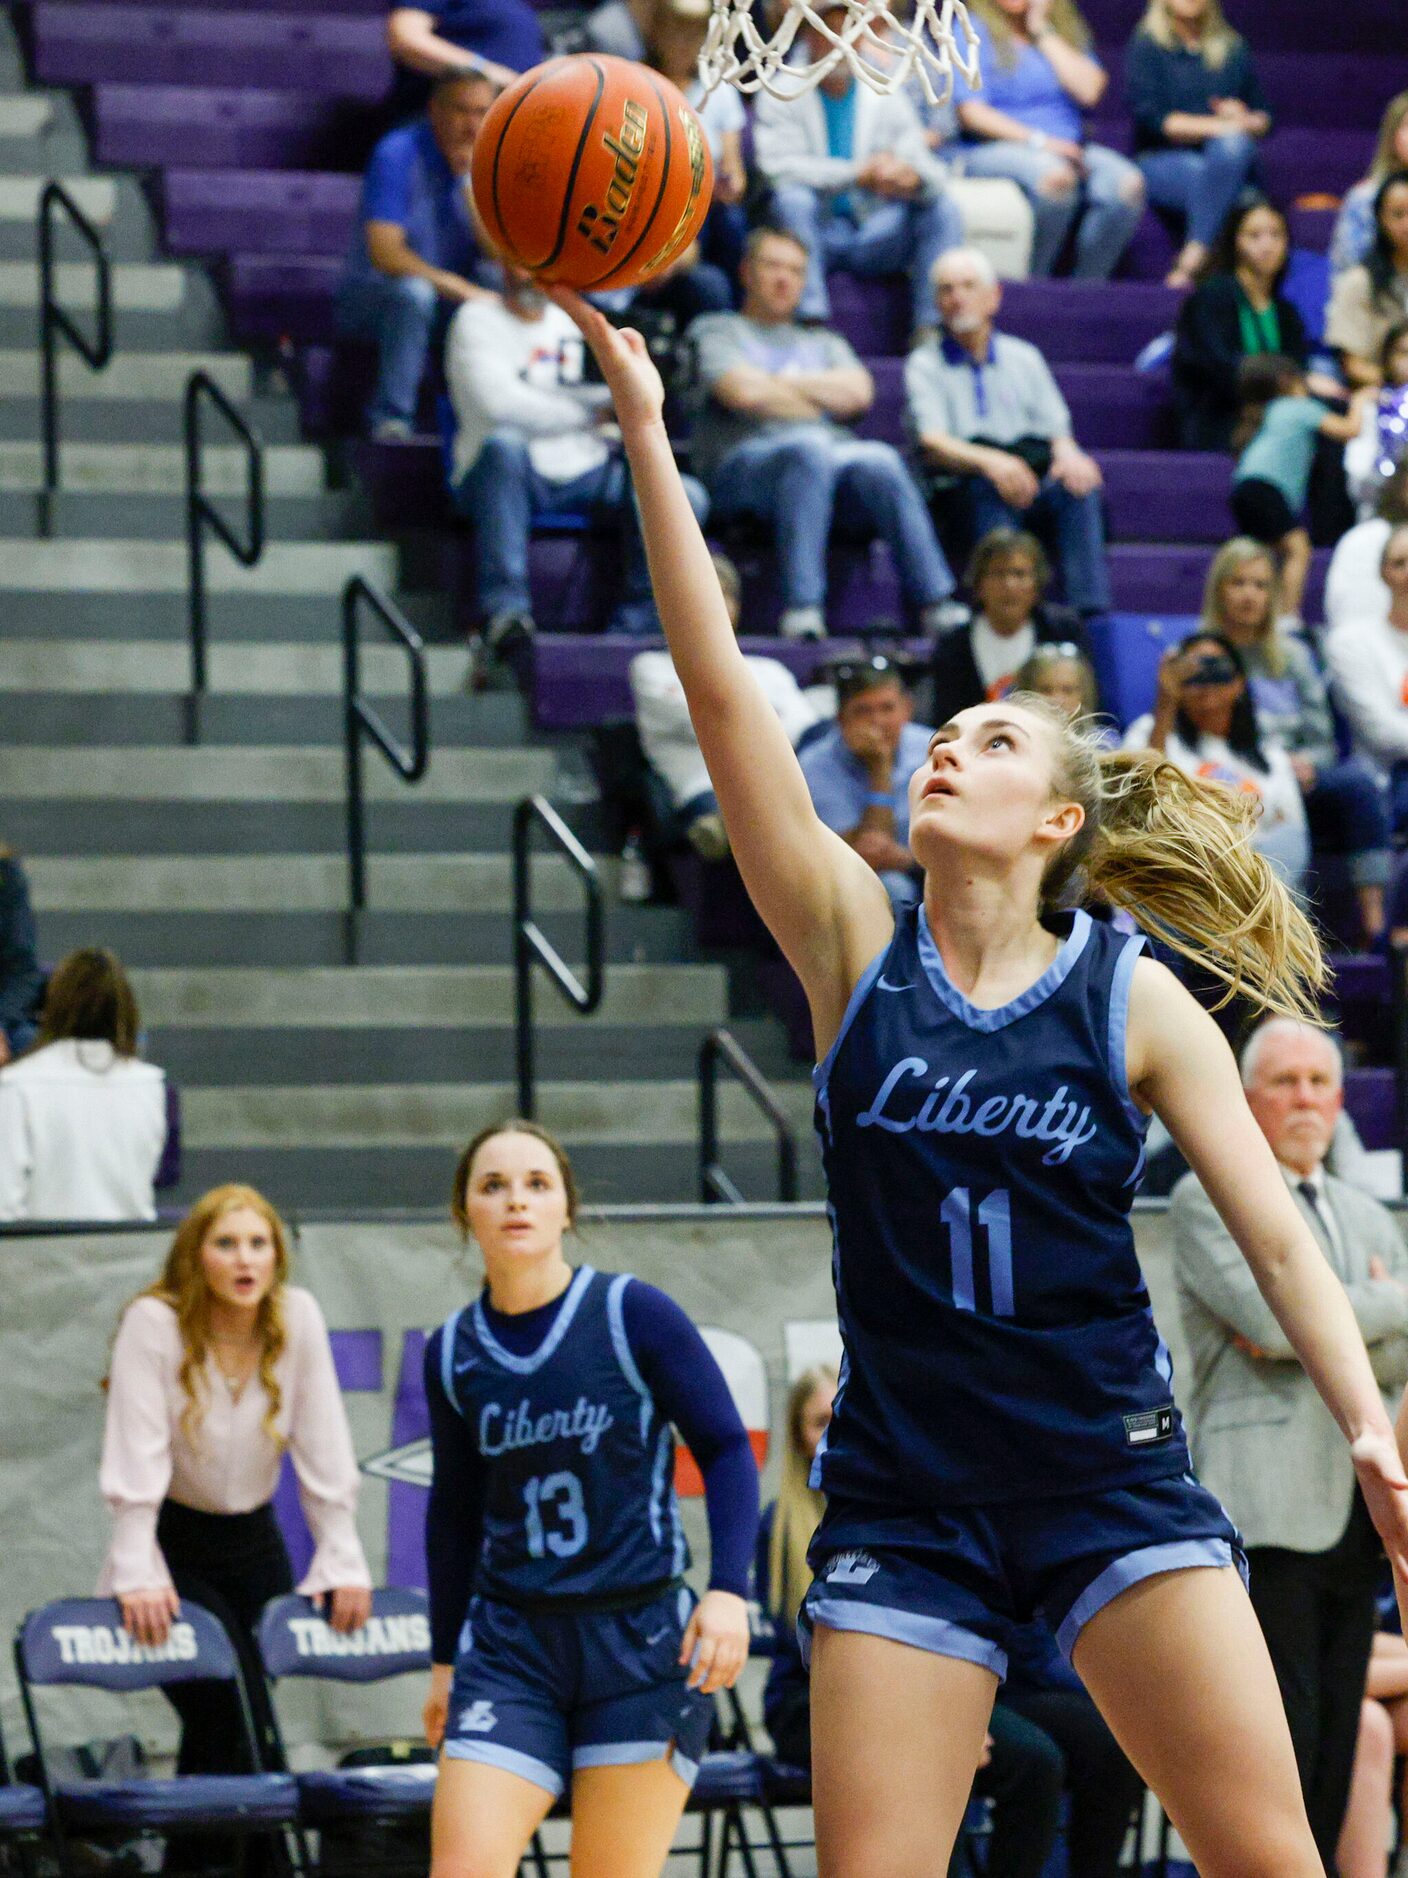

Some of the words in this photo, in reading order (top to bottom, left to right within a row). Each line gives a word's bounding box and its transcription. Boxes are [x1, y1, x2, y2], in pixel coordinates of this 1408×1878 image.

[577, 98, 648, 256] Baden
[856, 1056, 1097, 1166] Liberty
[939, 1186, 1016, 1317] 11
[479, 1397, 614, 1456] Liberty
[522, 1470, 589, 1559] 13
